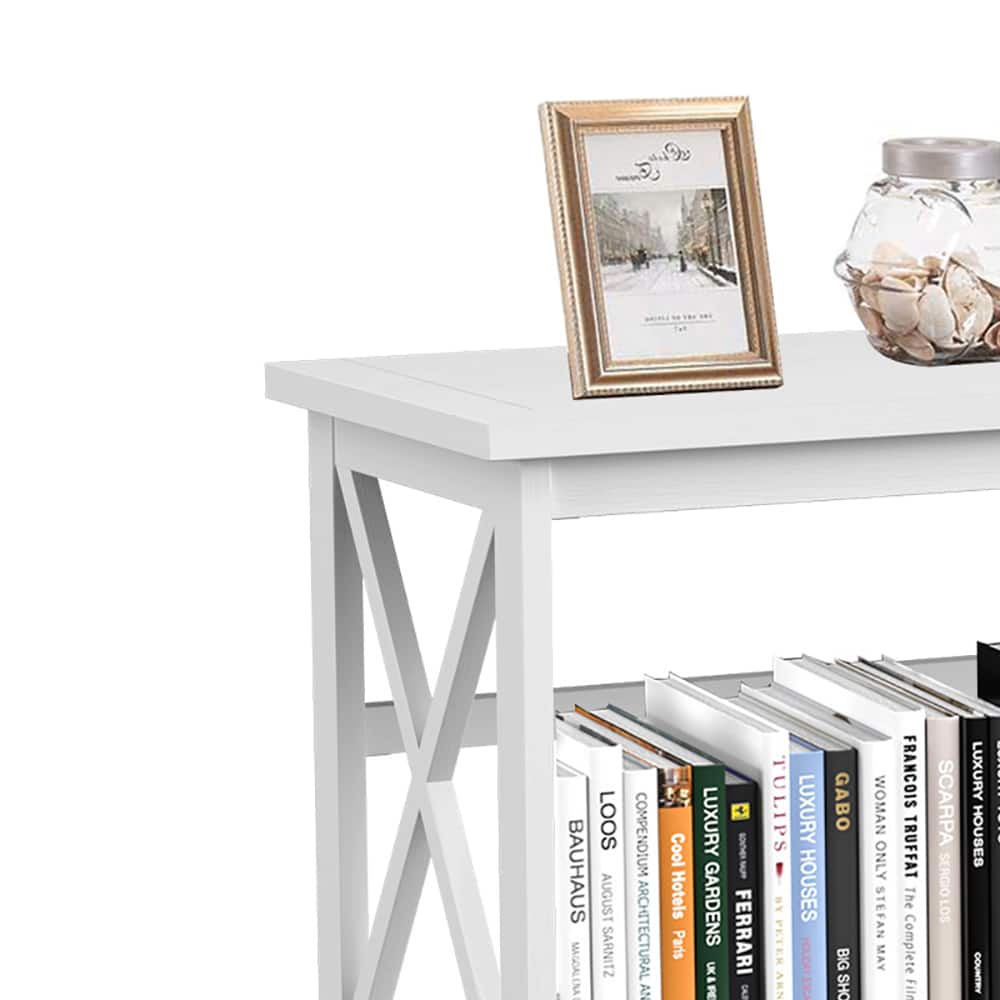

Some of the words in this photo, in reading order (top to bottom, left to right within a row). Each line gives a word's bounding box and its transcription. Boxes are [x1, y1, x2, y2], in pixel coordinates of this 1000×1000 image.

[834, 771, 851, 831] GABO
[903, 735, 917, 809] FRANCOIS
[972, 741, 984, 801] LUXURY
[600, 791, 617, 850] LOOS
[703, 787, 720, 857] LUXURY
[773, 754, 787, 852] TULIPS
[798, 774, 817, 844] LUXURY
[874, 775, 887, 835] WOMAN
[938, 759, 955, 847] SCARPA
[635, 792, 649, 877] COMPENDIUM
[671, 833, 686, 867] Cool
[875, 840, 888, 881] ONLY
[904, 814, 918, 878] TRUFFAT
[972, 805, 984, 868] HOUSES
[568, 819, 586, 924] BAUHAUS
[601, 873, 614, 922] AUGUST
[672, 871, 687, 920] Hotels
[800, 849, 818, 923] HOUSES
[904, 887, 917, 910] The
[638, 880, 651, 981] ARCHITECTURAL
[704, 861, 721, 947] GARDENS
[735, 889, 753, 976] FERRARI
[875, 885, 886, 939] STEFAN
[602, 926, 615, 979] SARNITZ
[672, 930, 687, 960] Paris
[775, 920, 784, 965] PETER
[836, 948, 850, 971] BIG
[876, 944, 886, 972] MAY
[902, 914, 917, 974] Complete
